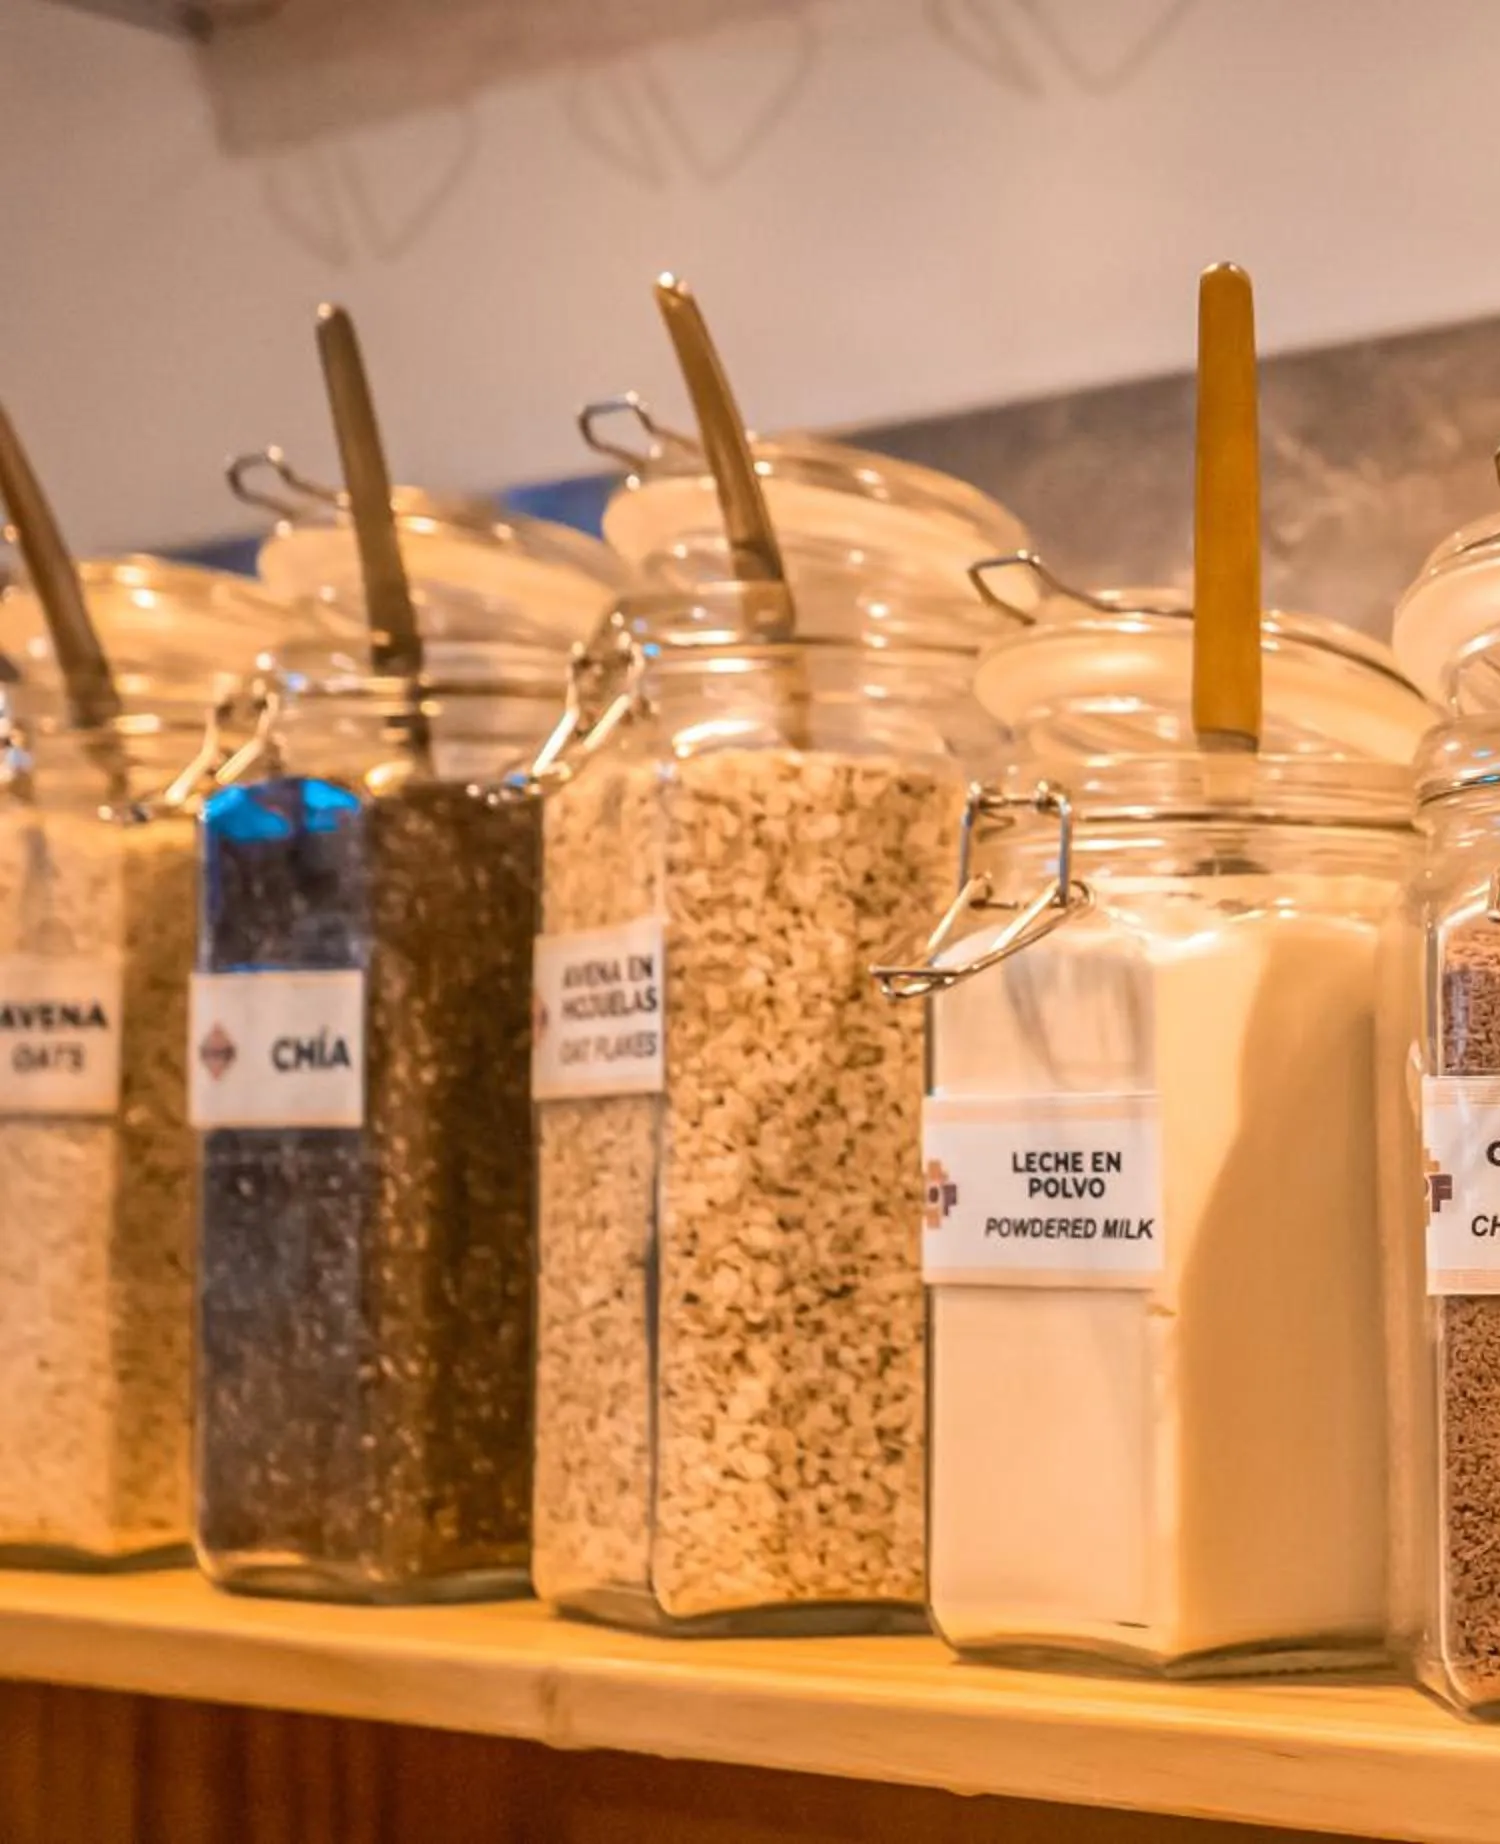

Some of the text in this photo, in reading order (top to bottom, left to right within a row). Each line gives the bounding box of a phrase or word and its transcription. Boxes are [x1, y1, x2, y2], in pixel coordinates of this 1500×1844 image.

[628, 956, 654, 982] EN
[0, 1000, 107, 1031] AVENA
[11, 1041, 86, 1074] OATS
[271, 1026, 351, 1071] CHÍA
[1012, 1151, 1121, 1173] LECHE EN
[1028, 1178, 1105, 1199] POLVO
[985, 1217, 1154, 1239] POWDERED MILK
